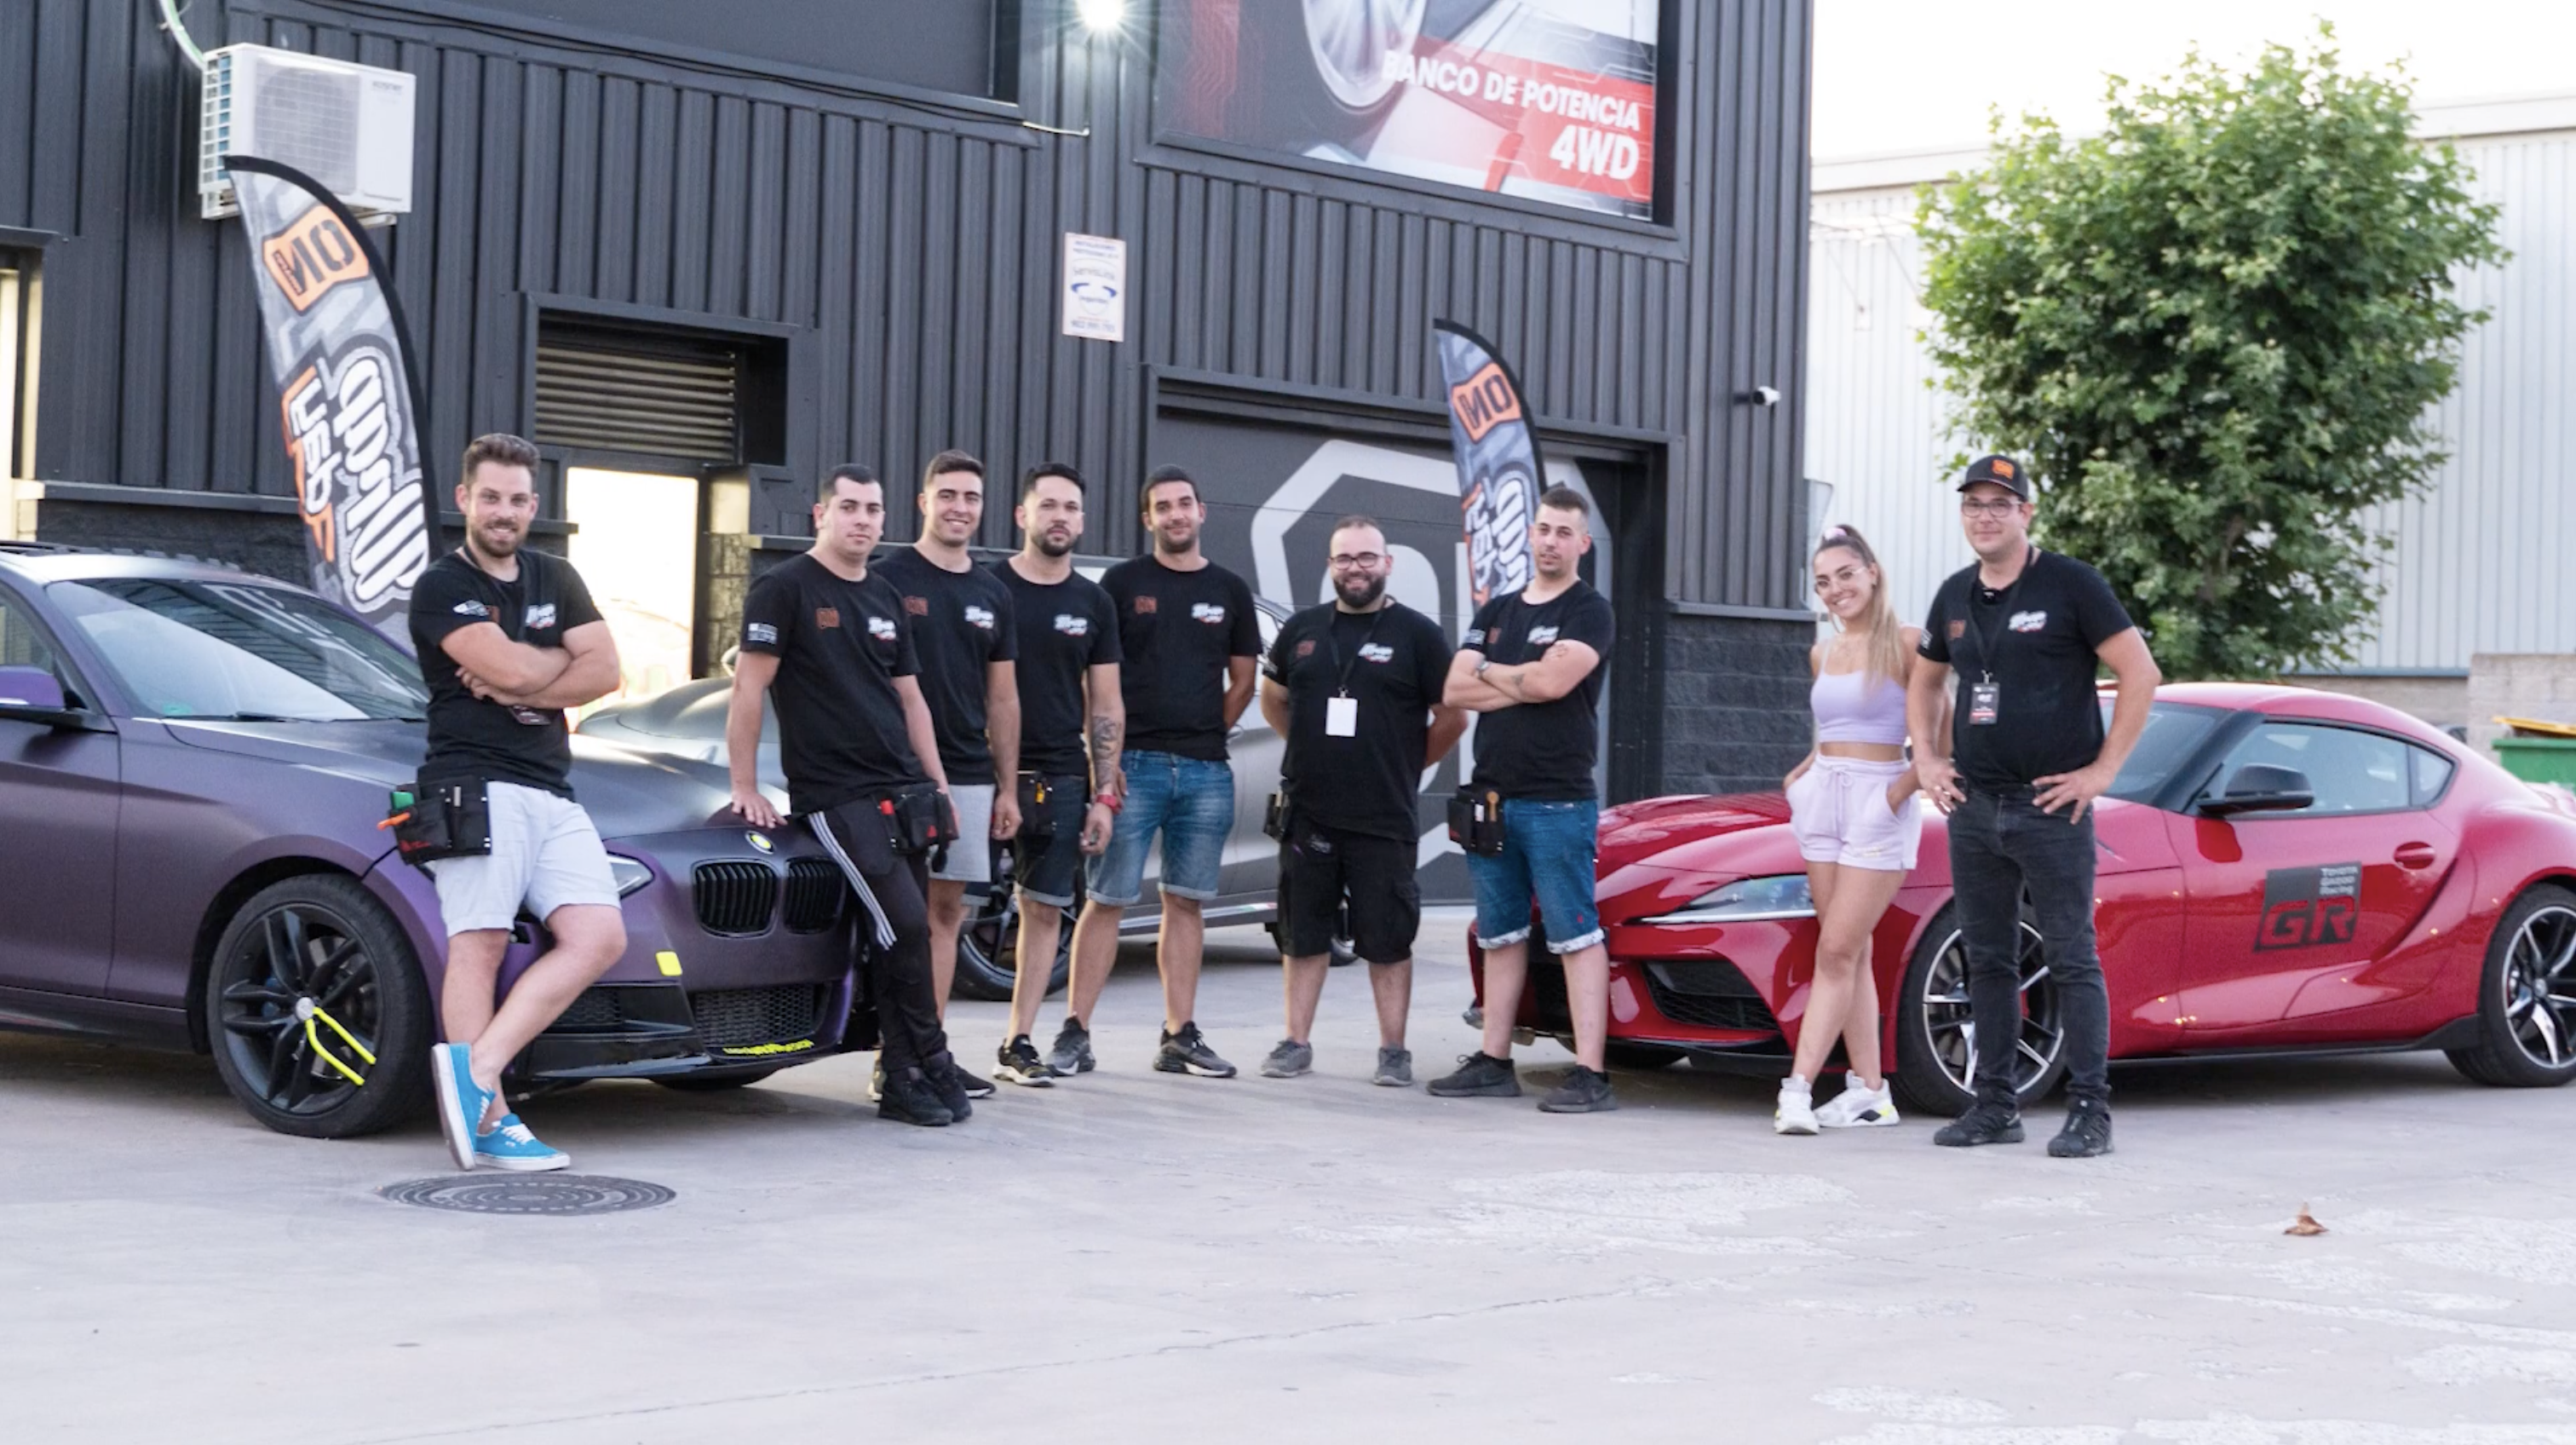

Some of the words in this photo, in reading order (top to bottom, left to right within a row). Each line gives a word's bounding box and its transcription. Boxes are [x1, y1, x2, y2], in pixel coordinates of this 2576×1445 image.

[1383, 51, 1478, 95] BANCO
[1484, 72, 1517, 105] DE
[1522, 79, 1639, 130] POTENCIA
[1550, 125, 1638, 179] 4WD
[2261, 897, 2355, 945] GR
